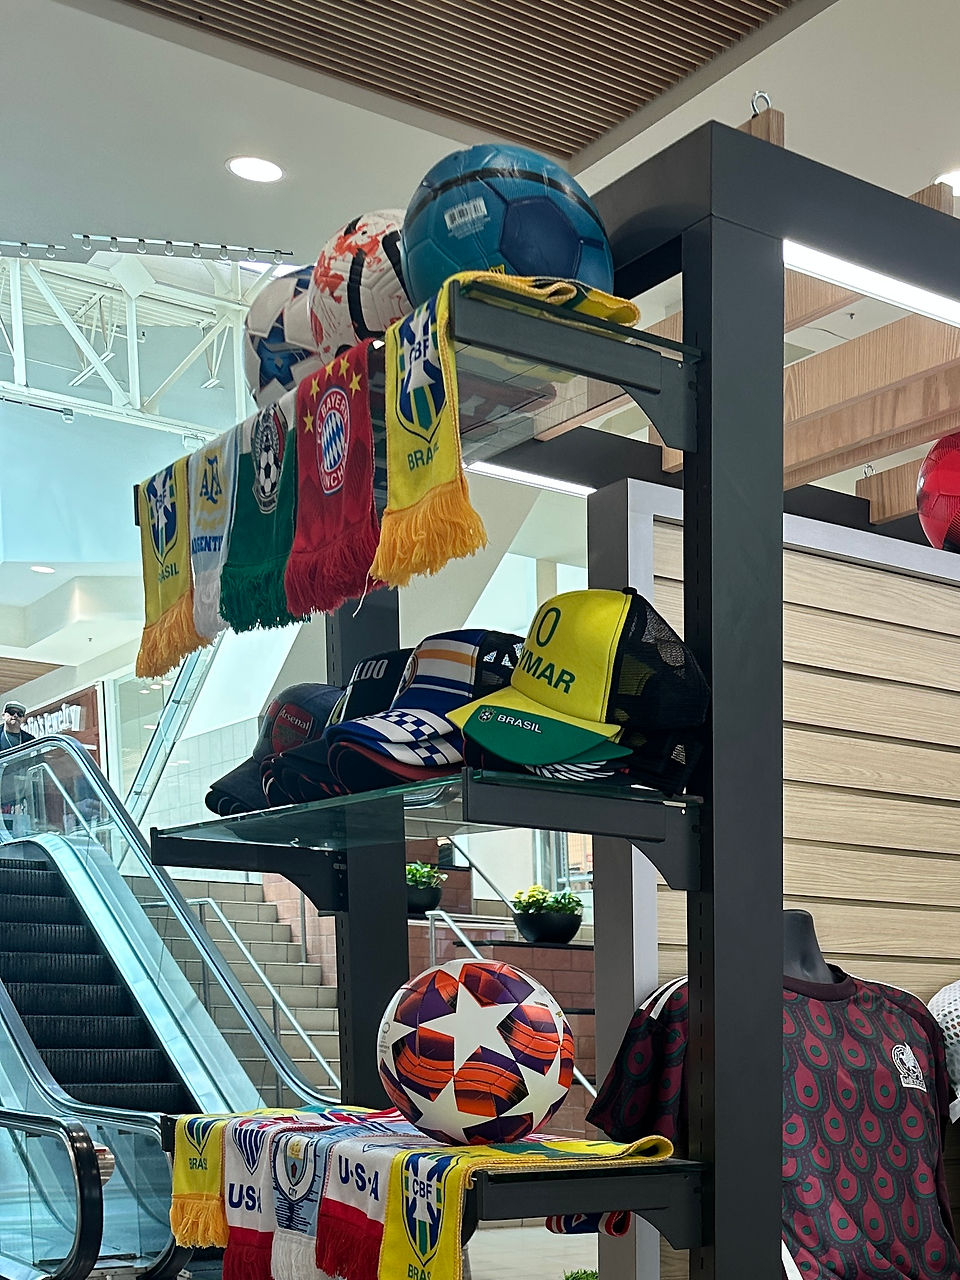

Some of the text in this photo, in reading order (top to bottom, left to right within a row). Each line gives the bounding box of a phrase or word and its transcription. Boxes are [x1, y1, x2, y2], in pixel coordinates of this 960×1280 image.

[279, 709, 312, 731] Arsenal
[497, 714, 542, 734] BRASIL
[412, 1178, 432, 1199] CBF
